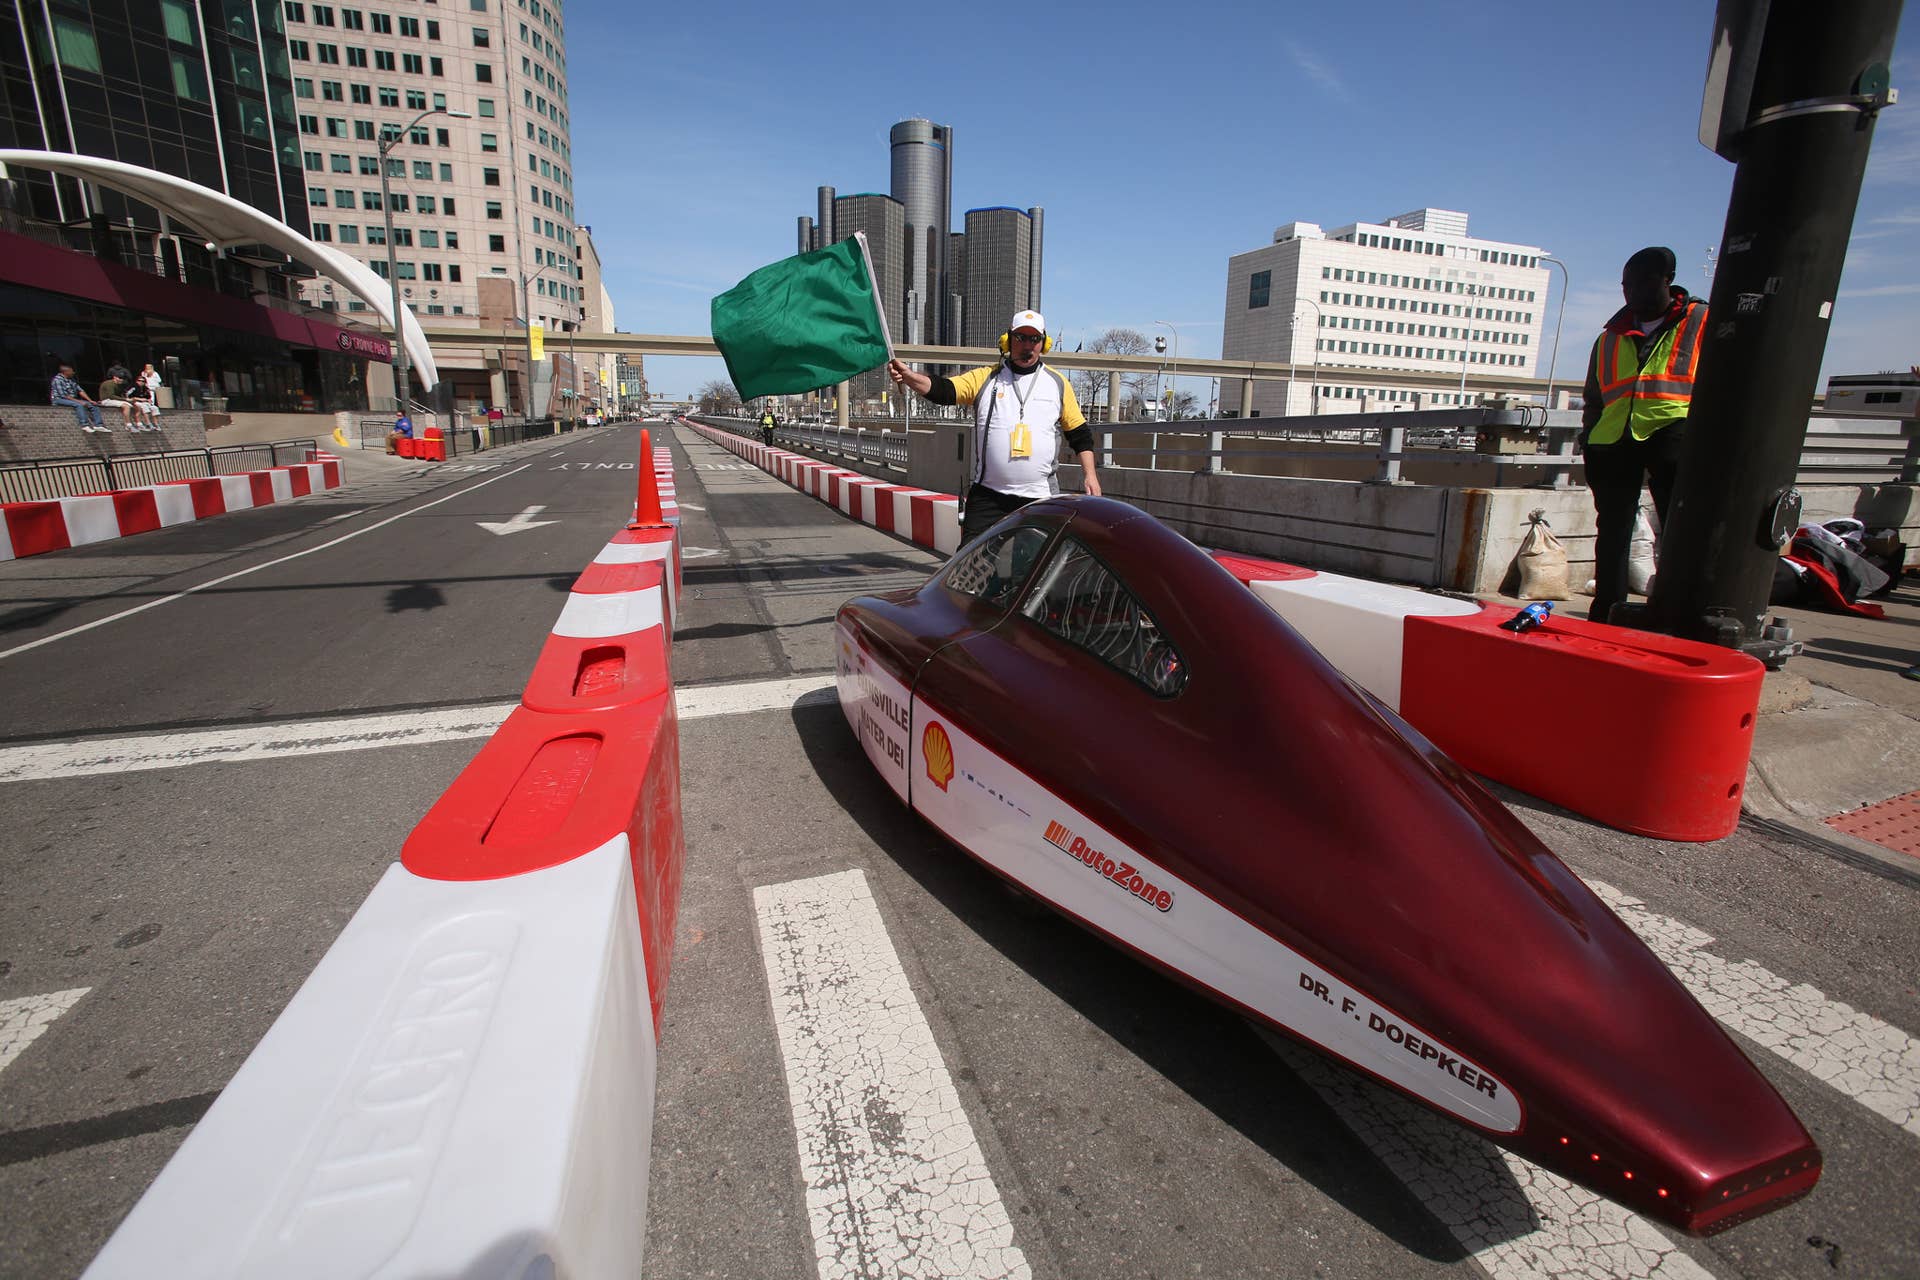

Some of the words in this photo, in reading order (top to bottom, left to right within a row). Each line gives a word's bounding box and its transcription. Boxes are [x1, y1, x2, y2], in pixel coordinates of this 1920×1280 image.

[548, 462, 635, 471] ONLY
[860, 707, 886, 752] MATER
[887, 738, 904, 770] DEI
[1068, 836, 1175, 914] AutoZone
[1298, 972, 1335, 1006] DR.
[1341, 996, 1361, 1022] F.
[1368, 1013, 1499, 1101] DOEPKER
